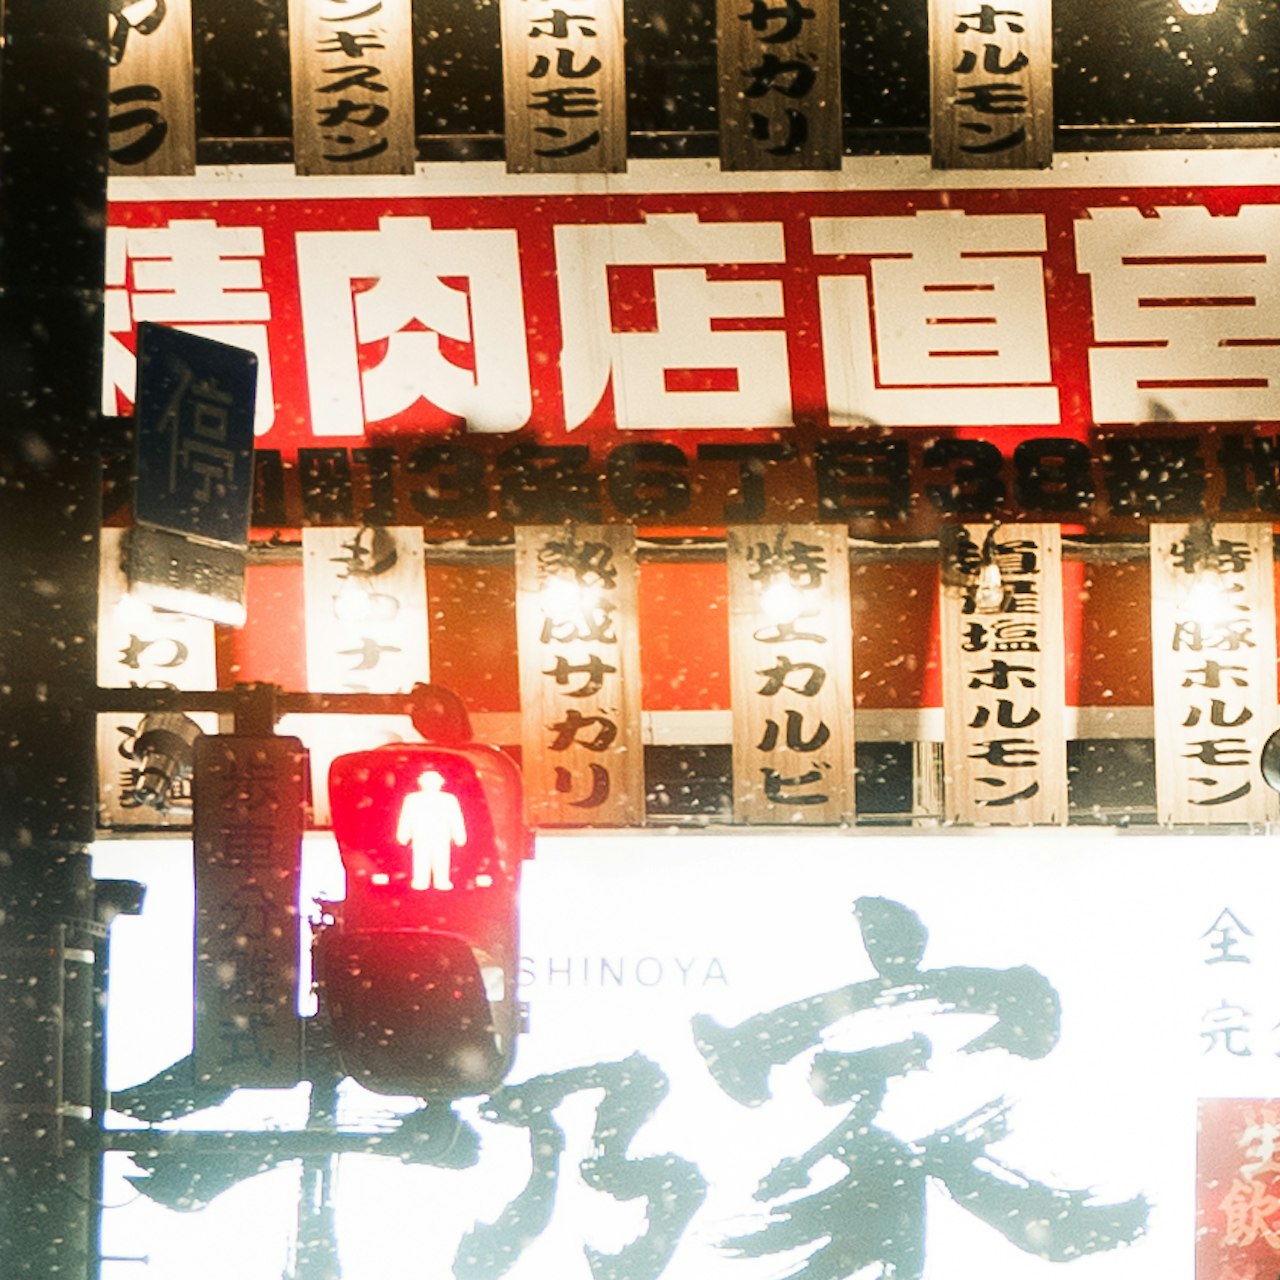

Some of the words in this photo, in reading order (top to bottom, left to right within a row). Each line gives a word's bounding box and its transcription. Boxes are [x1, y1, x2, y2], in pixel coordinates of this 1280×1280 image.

[527, 0, 603, 159] ホルモン
[738, 0, 818, 156] サガリ
[953, 3, 1029, 154] ホルモン
[1171, 537, 1256, 807] 特豚ホルモン
[1201, 906, 1255, 966] 全
